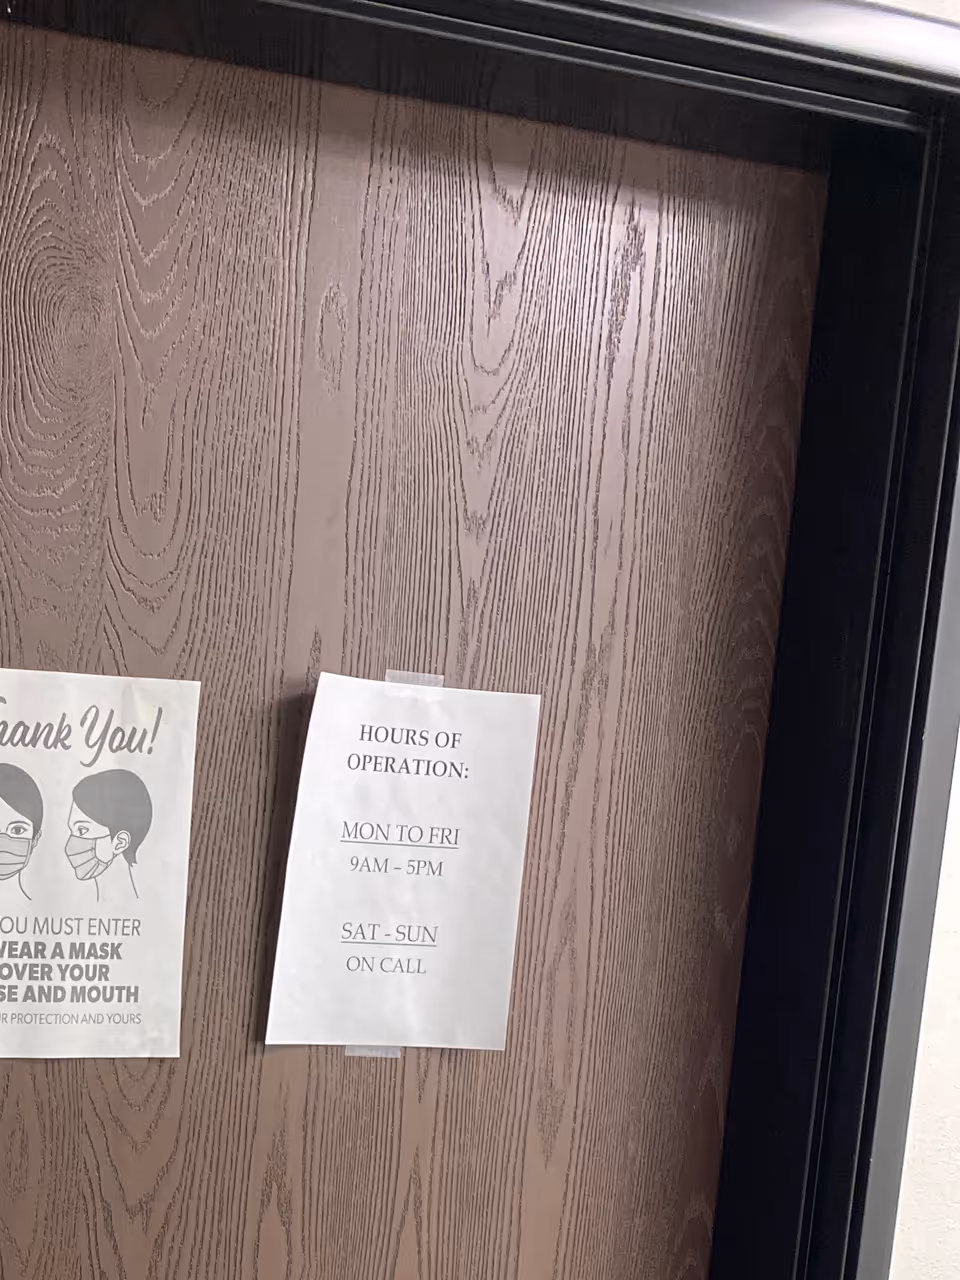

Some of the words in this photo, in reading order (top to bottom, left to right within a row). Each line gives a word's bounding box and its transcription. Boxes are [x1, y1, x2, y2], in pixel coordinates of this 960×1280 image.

[79, 704, 163, 768] You!
[359, 724, 429, 747] HOURS
[435, 731, 462, 749] OF
[347, 753, 469, 780] OPERATION:
[341, 820, 390, 843] MON
[396, 825, 424, 844] TO
[428, 827, 460, 846] FRI
[349, 856, 389, 874] 9AM
[407, 859, 444, 877] 5PM
[33, 916, 84, 936] MUST
[87, 918, 142, 938] ENTER
[341, 922, 381, 942] SAT
[395, 924, 439, 944] SUN
[49, 941, 65, 960] A
[68, 942, 123, 961] MASK
[57, 963, 110, 983] YOUR
[346, 955, 377, 973] ON
[380, 957, 427, 974] CALL
[22, 985, 67, 1004] AND
[70, 985, 140, 1004] MOUTH
[10, 1012, 79, 1025] PROTECTION
[80, 1012, 104, 1025] AND
[106, 1012, 142, 1025] YOURS
